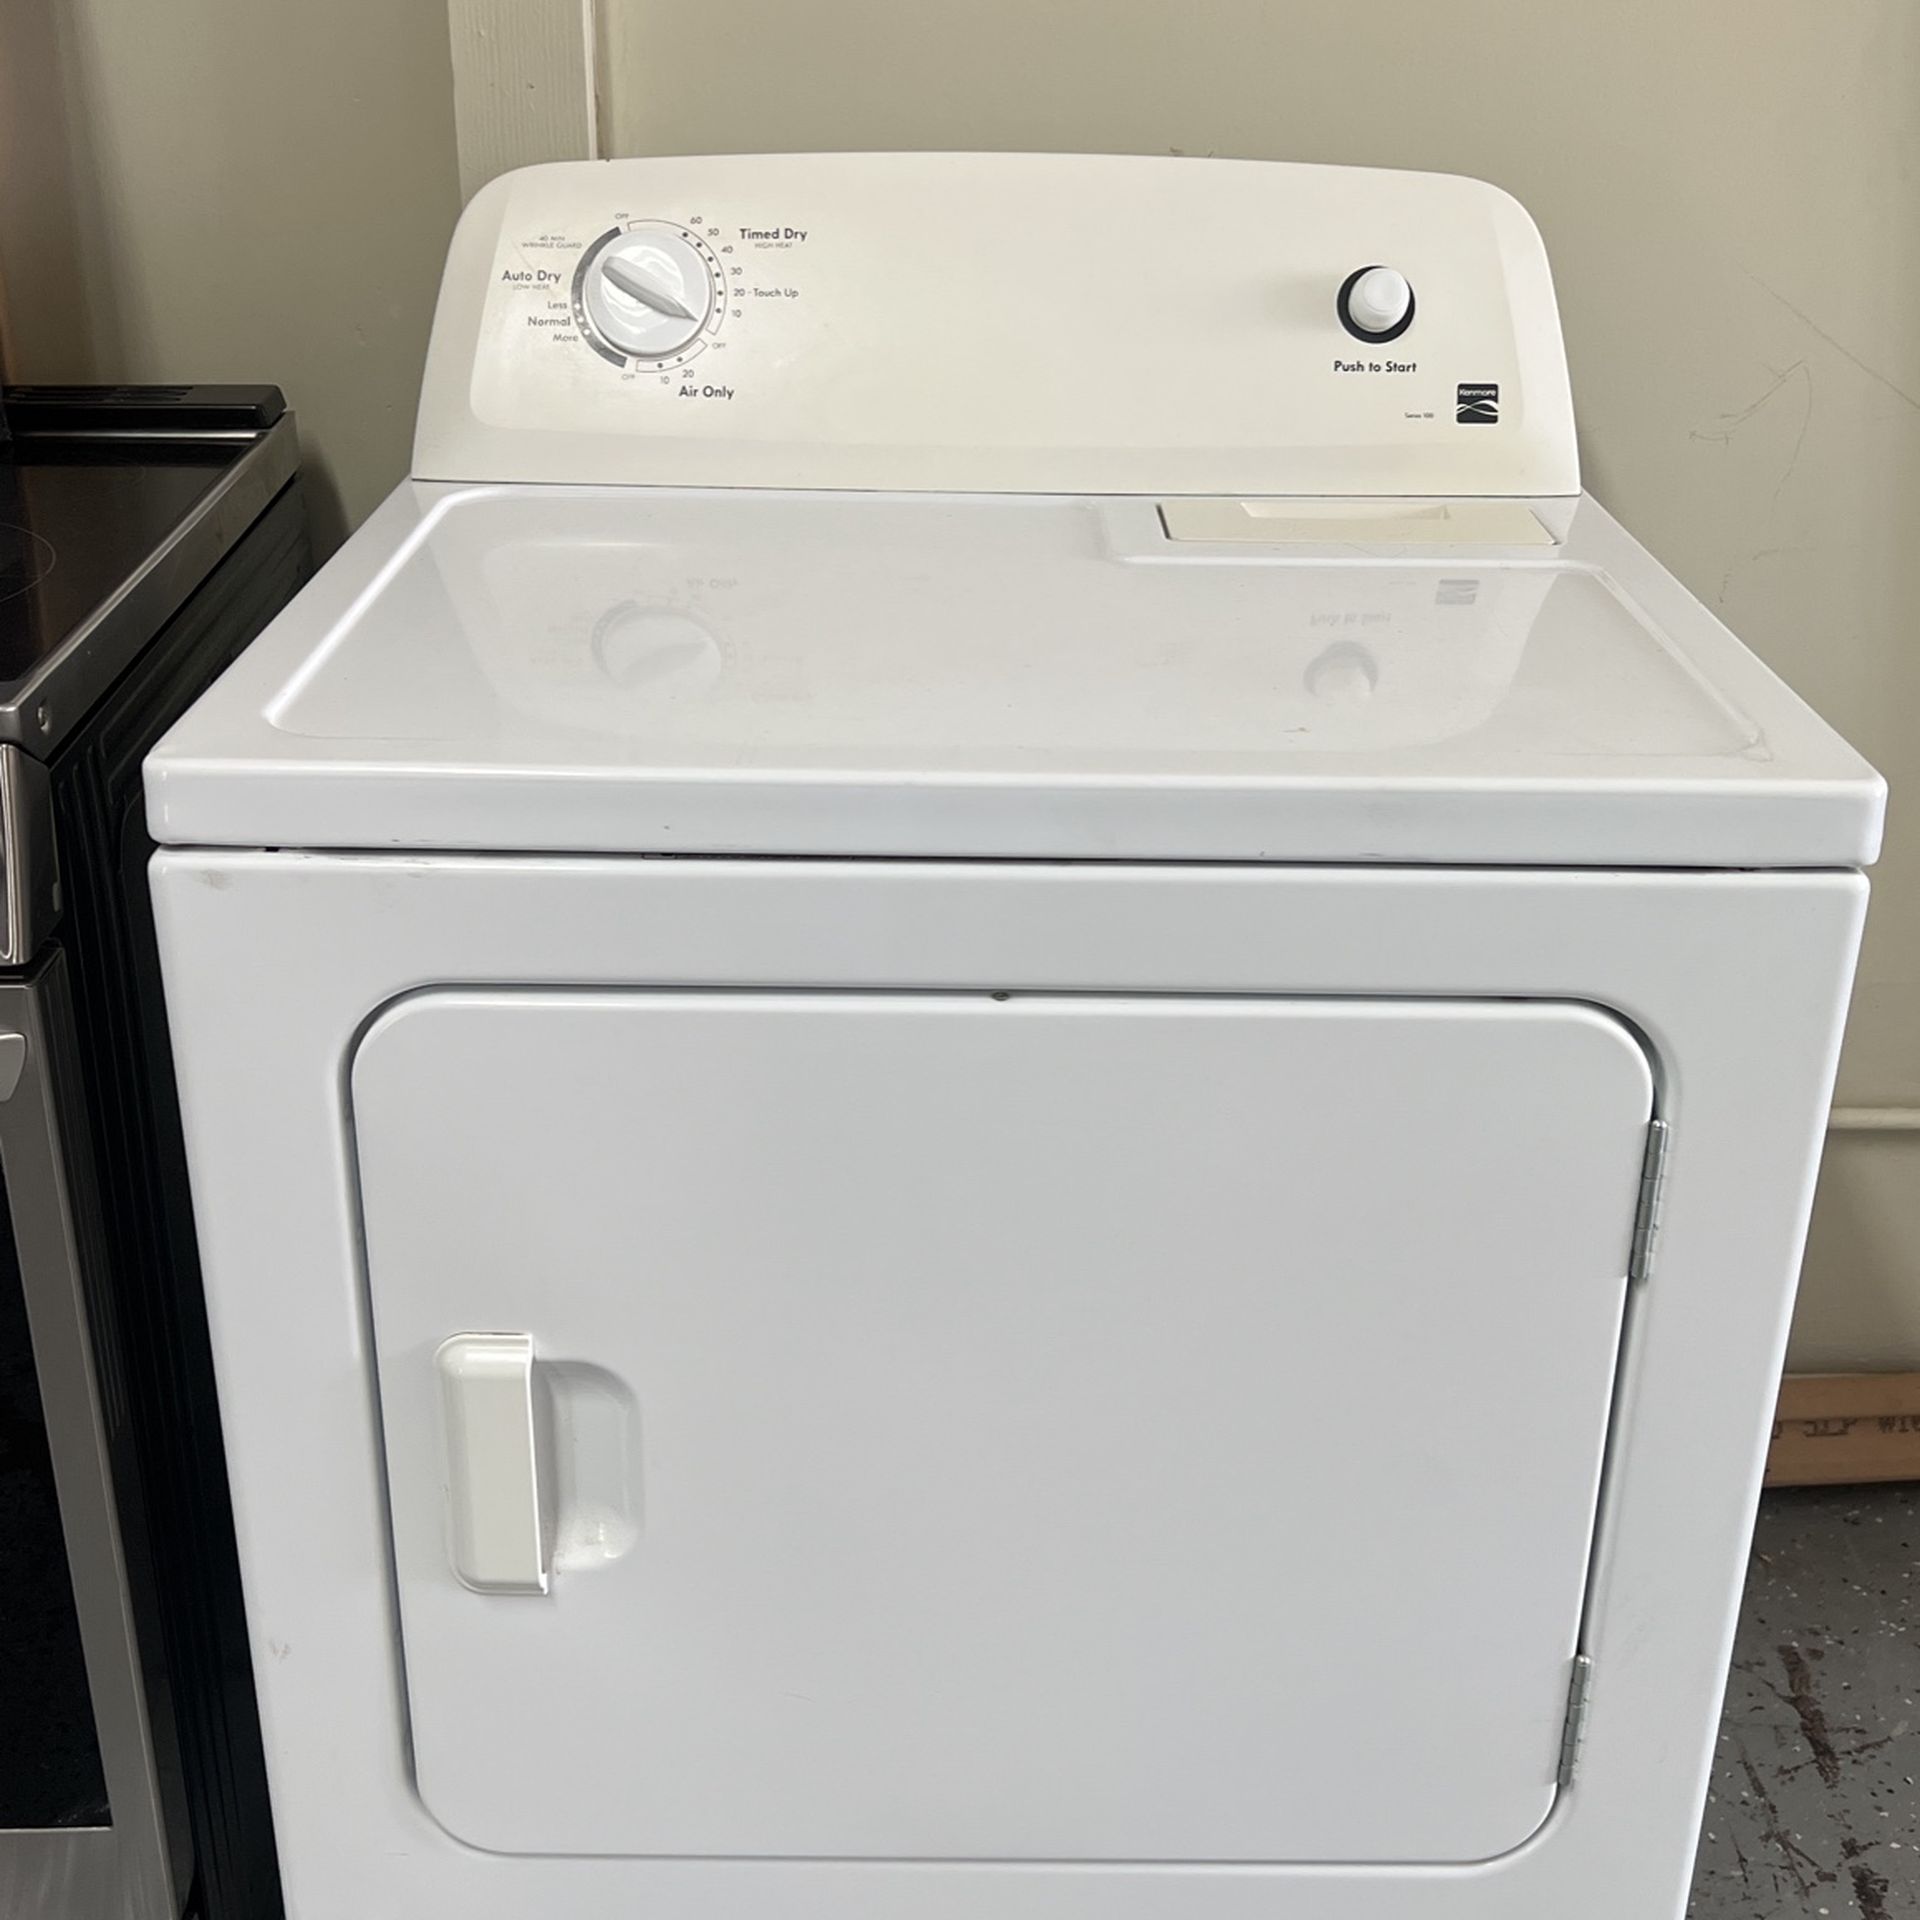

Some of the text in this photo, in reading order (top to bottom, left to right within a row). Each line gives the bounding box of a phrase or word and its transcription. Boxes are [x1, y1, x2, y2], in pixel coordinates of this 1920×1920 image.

[690, 216, 703, 225] 60
[707, 228, 719, 236] 50
[739, 227, 808, 242] Timed Dry
[721, 245, 734, 254] 40
[731, 267, 743, 276] 30
[502, 269, 562, 284] Auto Dry
[733, 288, 746, 297] 20
[753, 288, 781, 297] Touch
[784, 288, 799, 299] Up
[547, 301, 568, 310] Less
[732, 309, 742, 318] 10
[527, 316, 571, 327] Normal
[552, 334, 579, 342] More
[1334, 361, 1417, 373] Push to Start
[682, 369, 695, 379] 20
[660, 376, 670, 385] 10
[679, 385, 735, 400] Air Only
[1458, 389, 1497, 397] Kenmore
